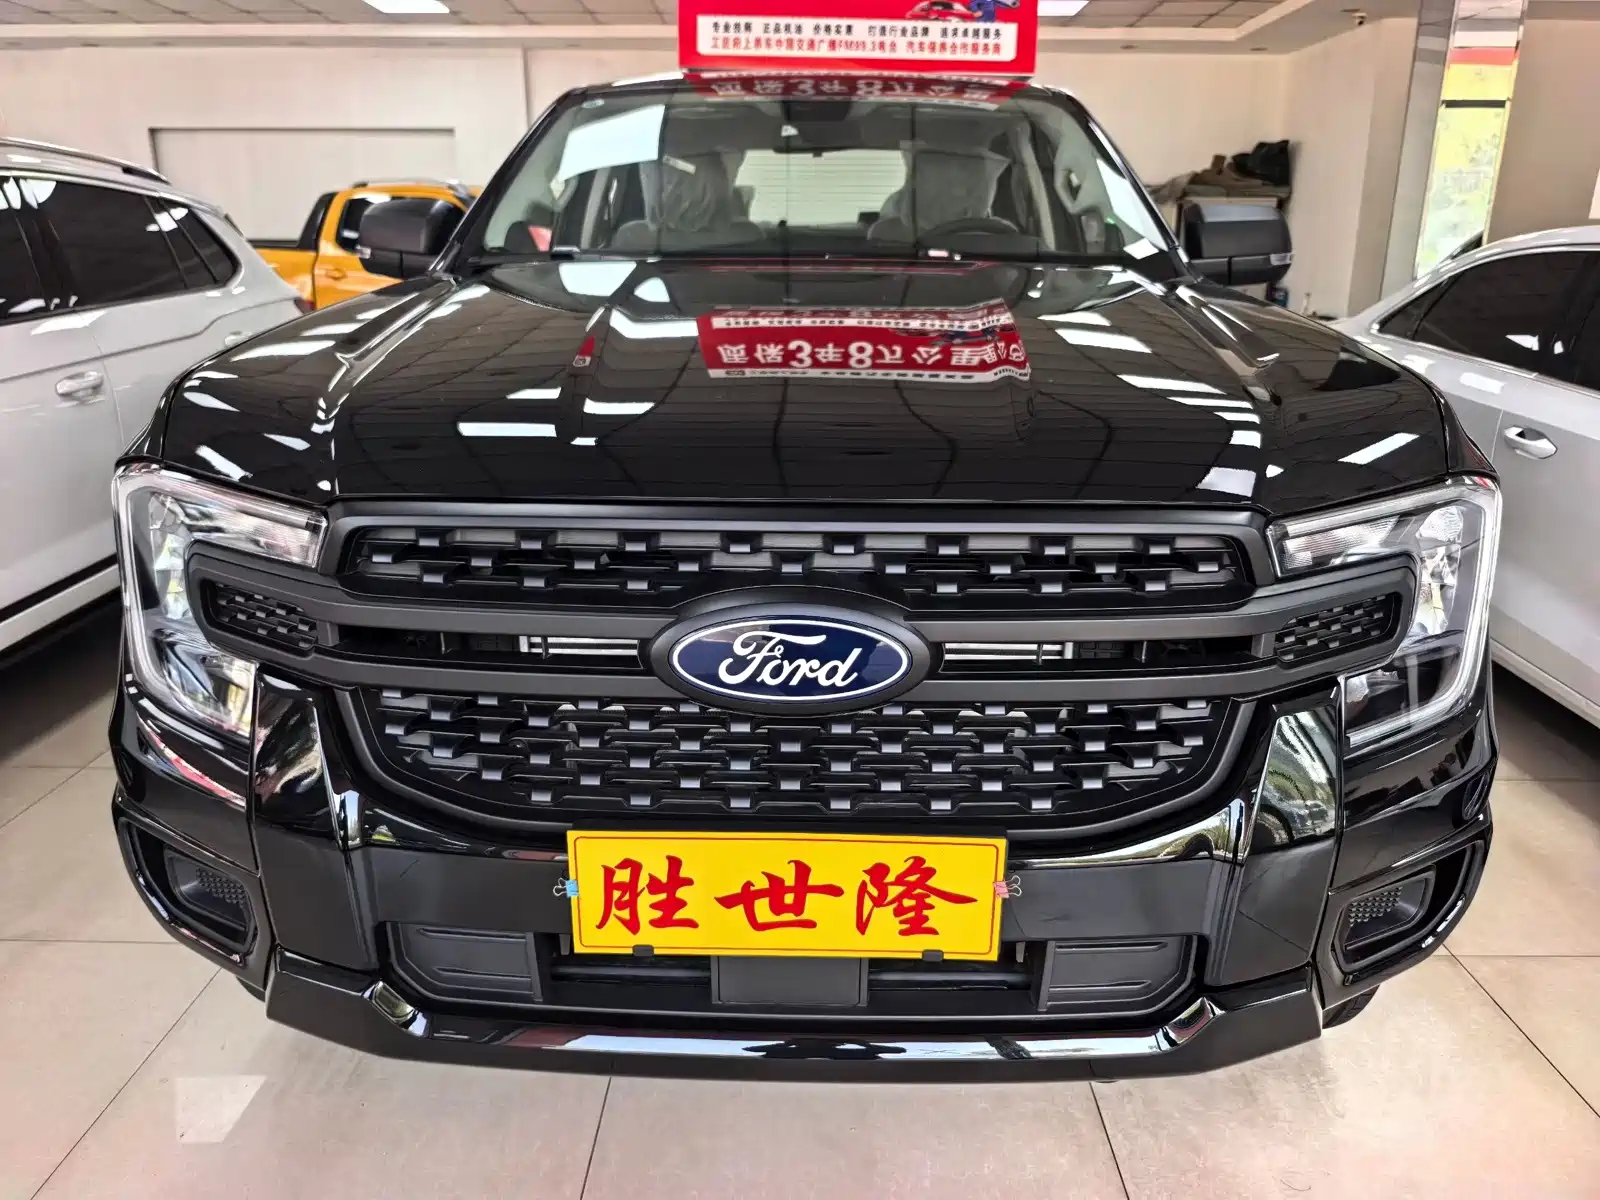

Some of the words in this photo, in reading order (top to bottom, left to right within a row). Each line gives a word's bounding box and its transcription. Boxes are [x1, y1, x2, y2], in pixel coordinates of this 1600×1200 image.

[712, 22, 753, 34] 专业技师
[763, 23, 805, 35] 正品机油
[813, 24, 854, 36] 价格实惠
[718, 630, 863, 687] Ford
[595, 855, 978, 936] 胜世隆
